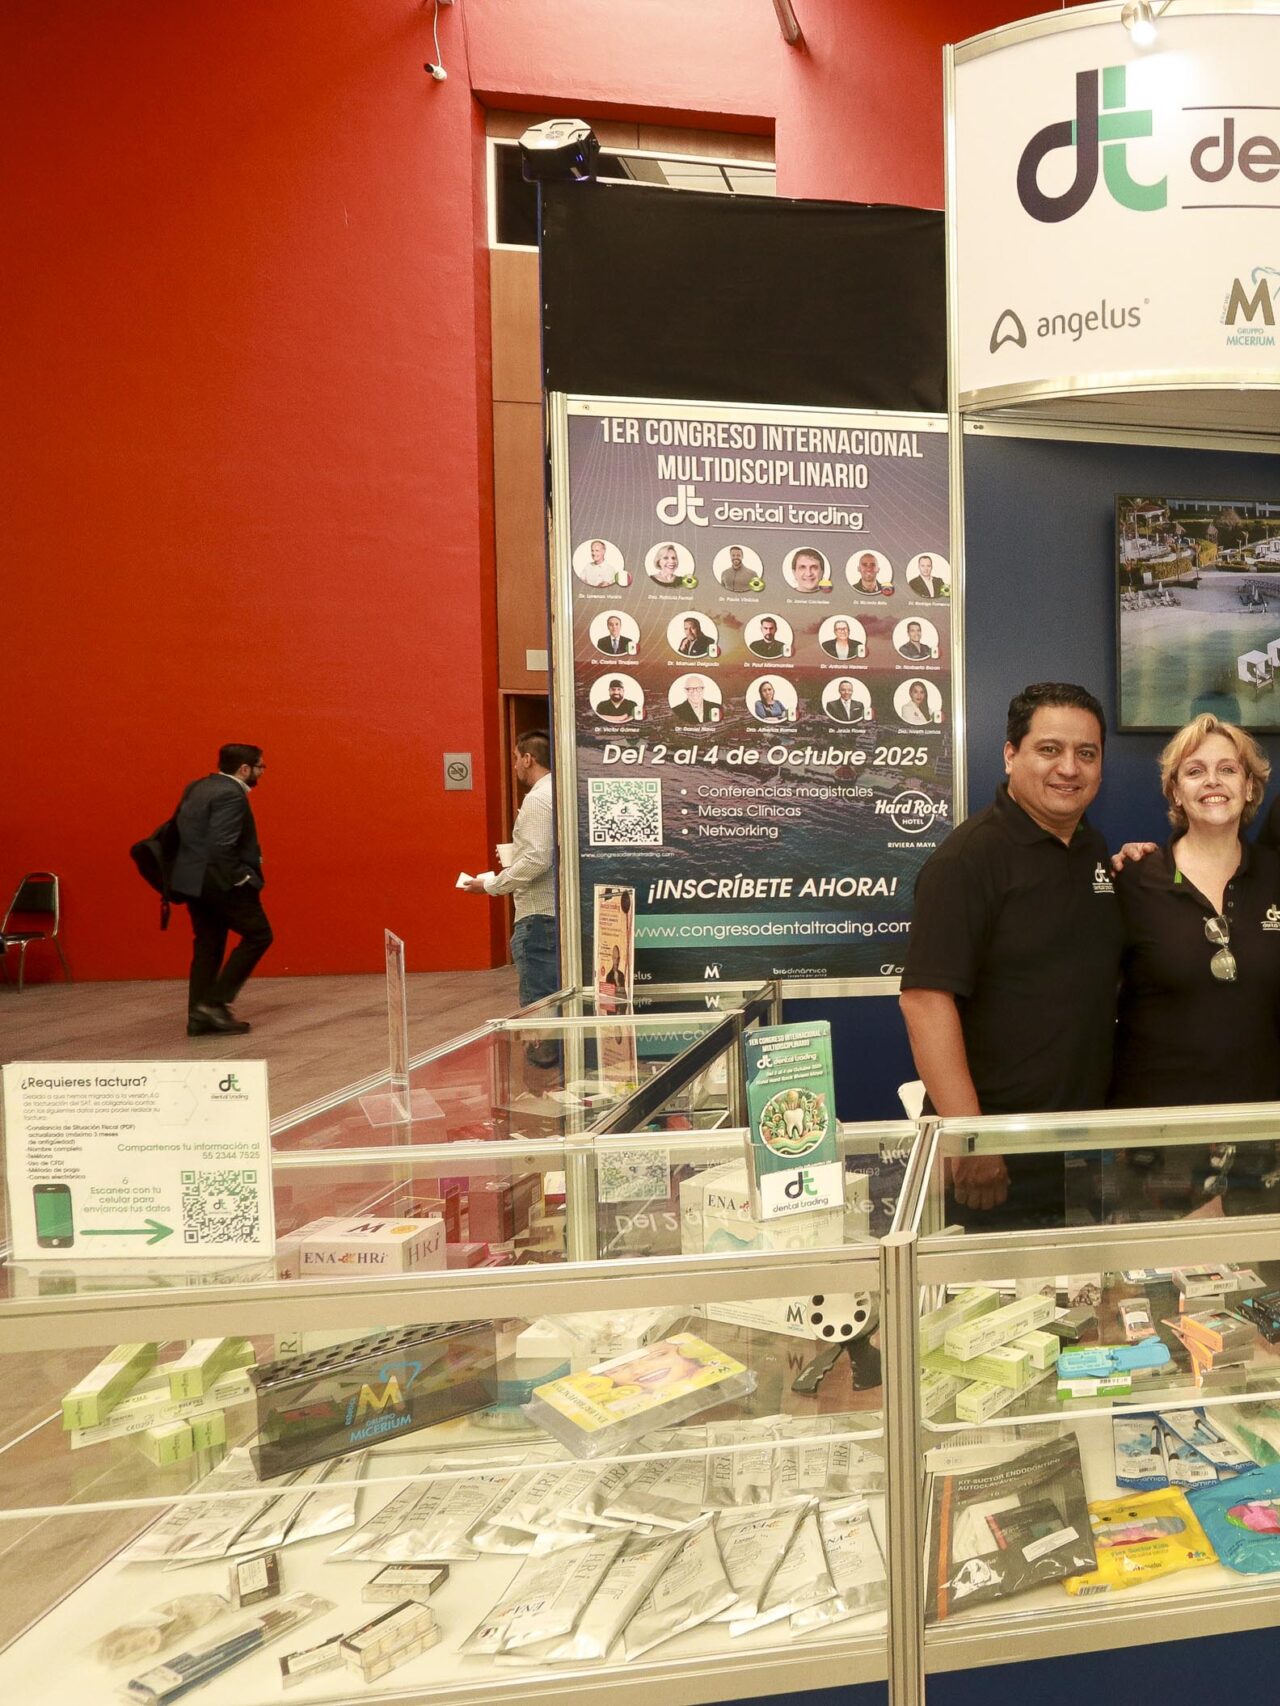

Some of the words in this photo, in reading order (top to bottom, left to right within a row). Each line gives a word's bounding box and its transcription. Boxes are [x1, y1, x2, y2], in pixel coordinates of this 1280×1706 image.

[1224, 278, 1276, 326] M
[1036, 299, 1141, 342] angelus
[1226, 336, 1276, 346] MICERIUM
[600, 418, 640, 445] 1ER
[645, 420, 757, 450] CONGRESO
[762, 426, 924, 458] INTERNACIONAL
[656, 455, 869, 489] MULTIDISCIPLINARIO
[714, 501, 784, 524] dental
[788, 505, 864, 530] trading
[602, 745, 644, 766] Del
[651, 747, 667, 765] 2
[673, 745, 697, 765] al
[703, 746, 719, 765] 4
[726, 745, 760, 766] de
[767, 745, 867, 766] Octubre
[872, 746, 929, 766] 2025
[697, 784, 793, 799] Conferencias
[795, 784, 874, 800] magistrales
[697, 804, 744, 818] Mesas
[746, 803, 802, 818] Clínicas
[874, 800, 911, 817] Hard
[913, 800, 949, 818] Rock
[901, 818, 925, 826] HOTEL
[698, 823, 780, 839] Networking
[647, 873, 793, 904] ¡INSCRÍBETE
[798, 877, 897, 898] AHORA!
[704, 965, 720, 979] M
[21, 1076, 91, 1090] ¿Requieres
[95, 1075, 148, 1087] factura?
[182, 1143, 192, 1151] tu
[194, 1142, 250, 1151] información
[252, 1142, 260, 1150] al
[216, 1152, 236, 1160] 2344
[239, 1151, 260, 1159] 7525
[90, 1186, 131, 1195] Escanea
[152, 1186, 162, 1194] tu
[98, 1195, 130, 1204] celular
[132, 1196, 154, 1205] para
[145, 1203, 171, 1213] datos
[707, 1193, 737, 1211] ENA
[773, 1201, 800, 1213] dental
[800, 1197, 829, 1209] trading
[304, 1252, 337, 1264] ENA
[357, 1252, 386, 1264] HRi
[786, 1304, 804, 1325] M
[350, 1415, 412, 1443] MICERIUM
